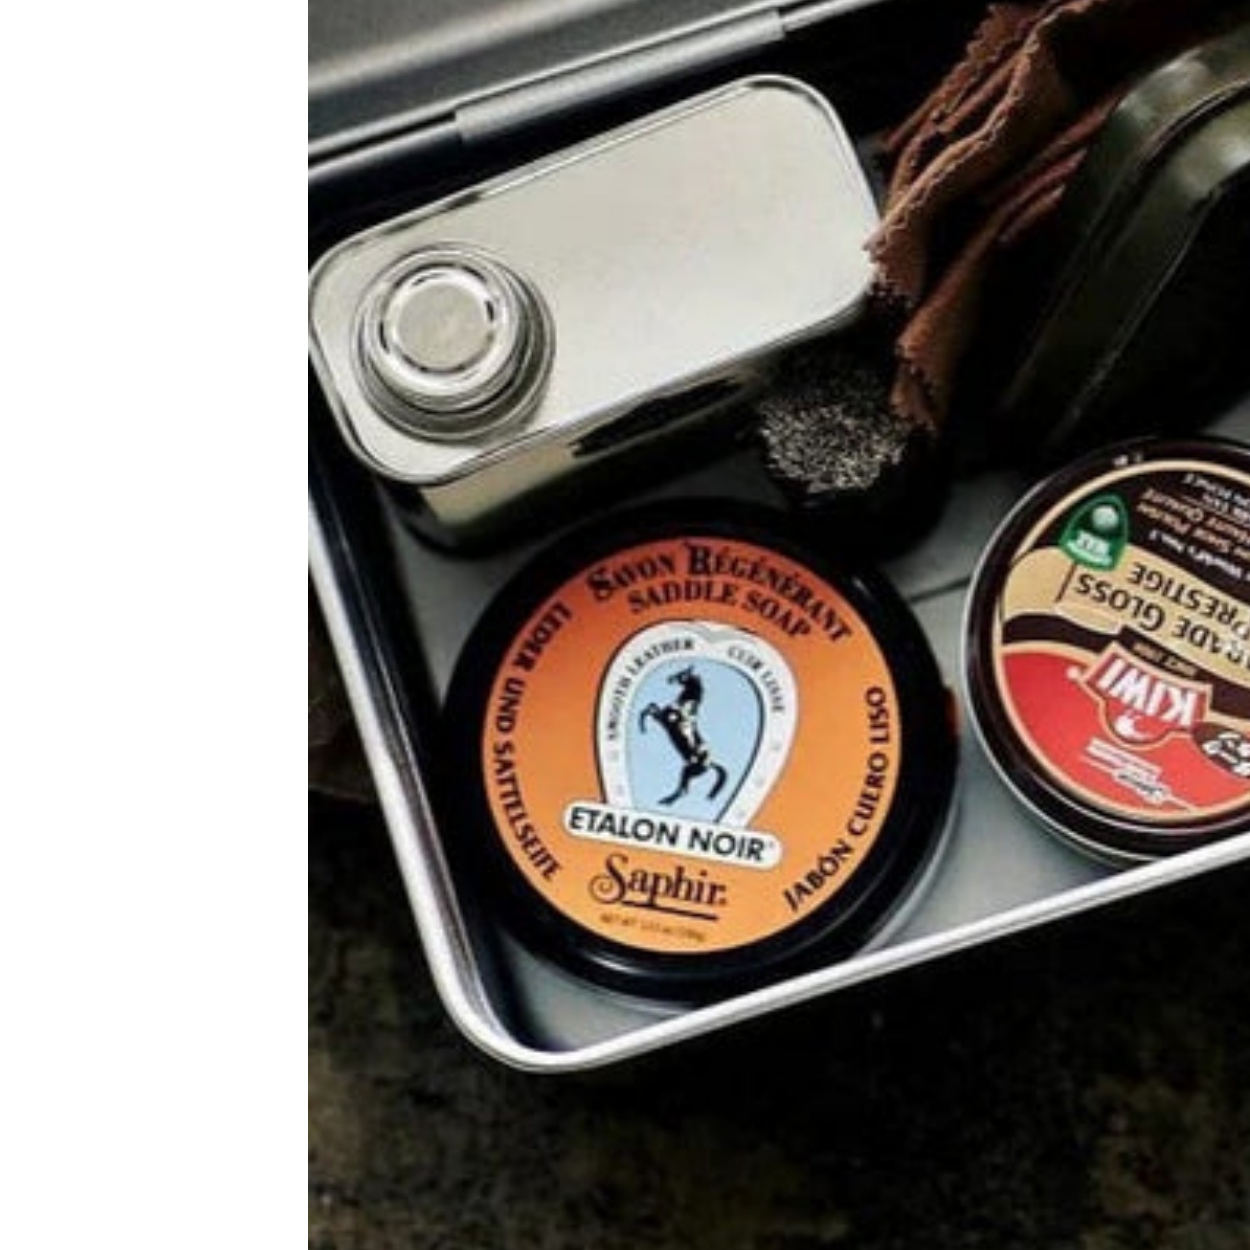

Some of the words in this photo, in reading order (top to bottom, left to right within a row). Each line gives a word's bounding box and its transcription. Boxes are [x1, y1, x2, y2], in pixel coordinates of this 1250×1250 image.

[628, 578, 738, 615] SADDLE
[741, 589, 811, 638] SOAP
[1076, 573, 1167, 632] GLOSS
[513, 601, 573, 673] LEDER
[496, 676, 526, 735] UND
[865, 686, 891, 744] LISO
[1096, 656, 1198, 727] KIWI
[493, 740, 562, 883] SATTELSEIFE
[847, 751, 889, 837] CUERO
[569, 806, 680, 846] ETALON
[687, 827, 766, 862] NOIR
